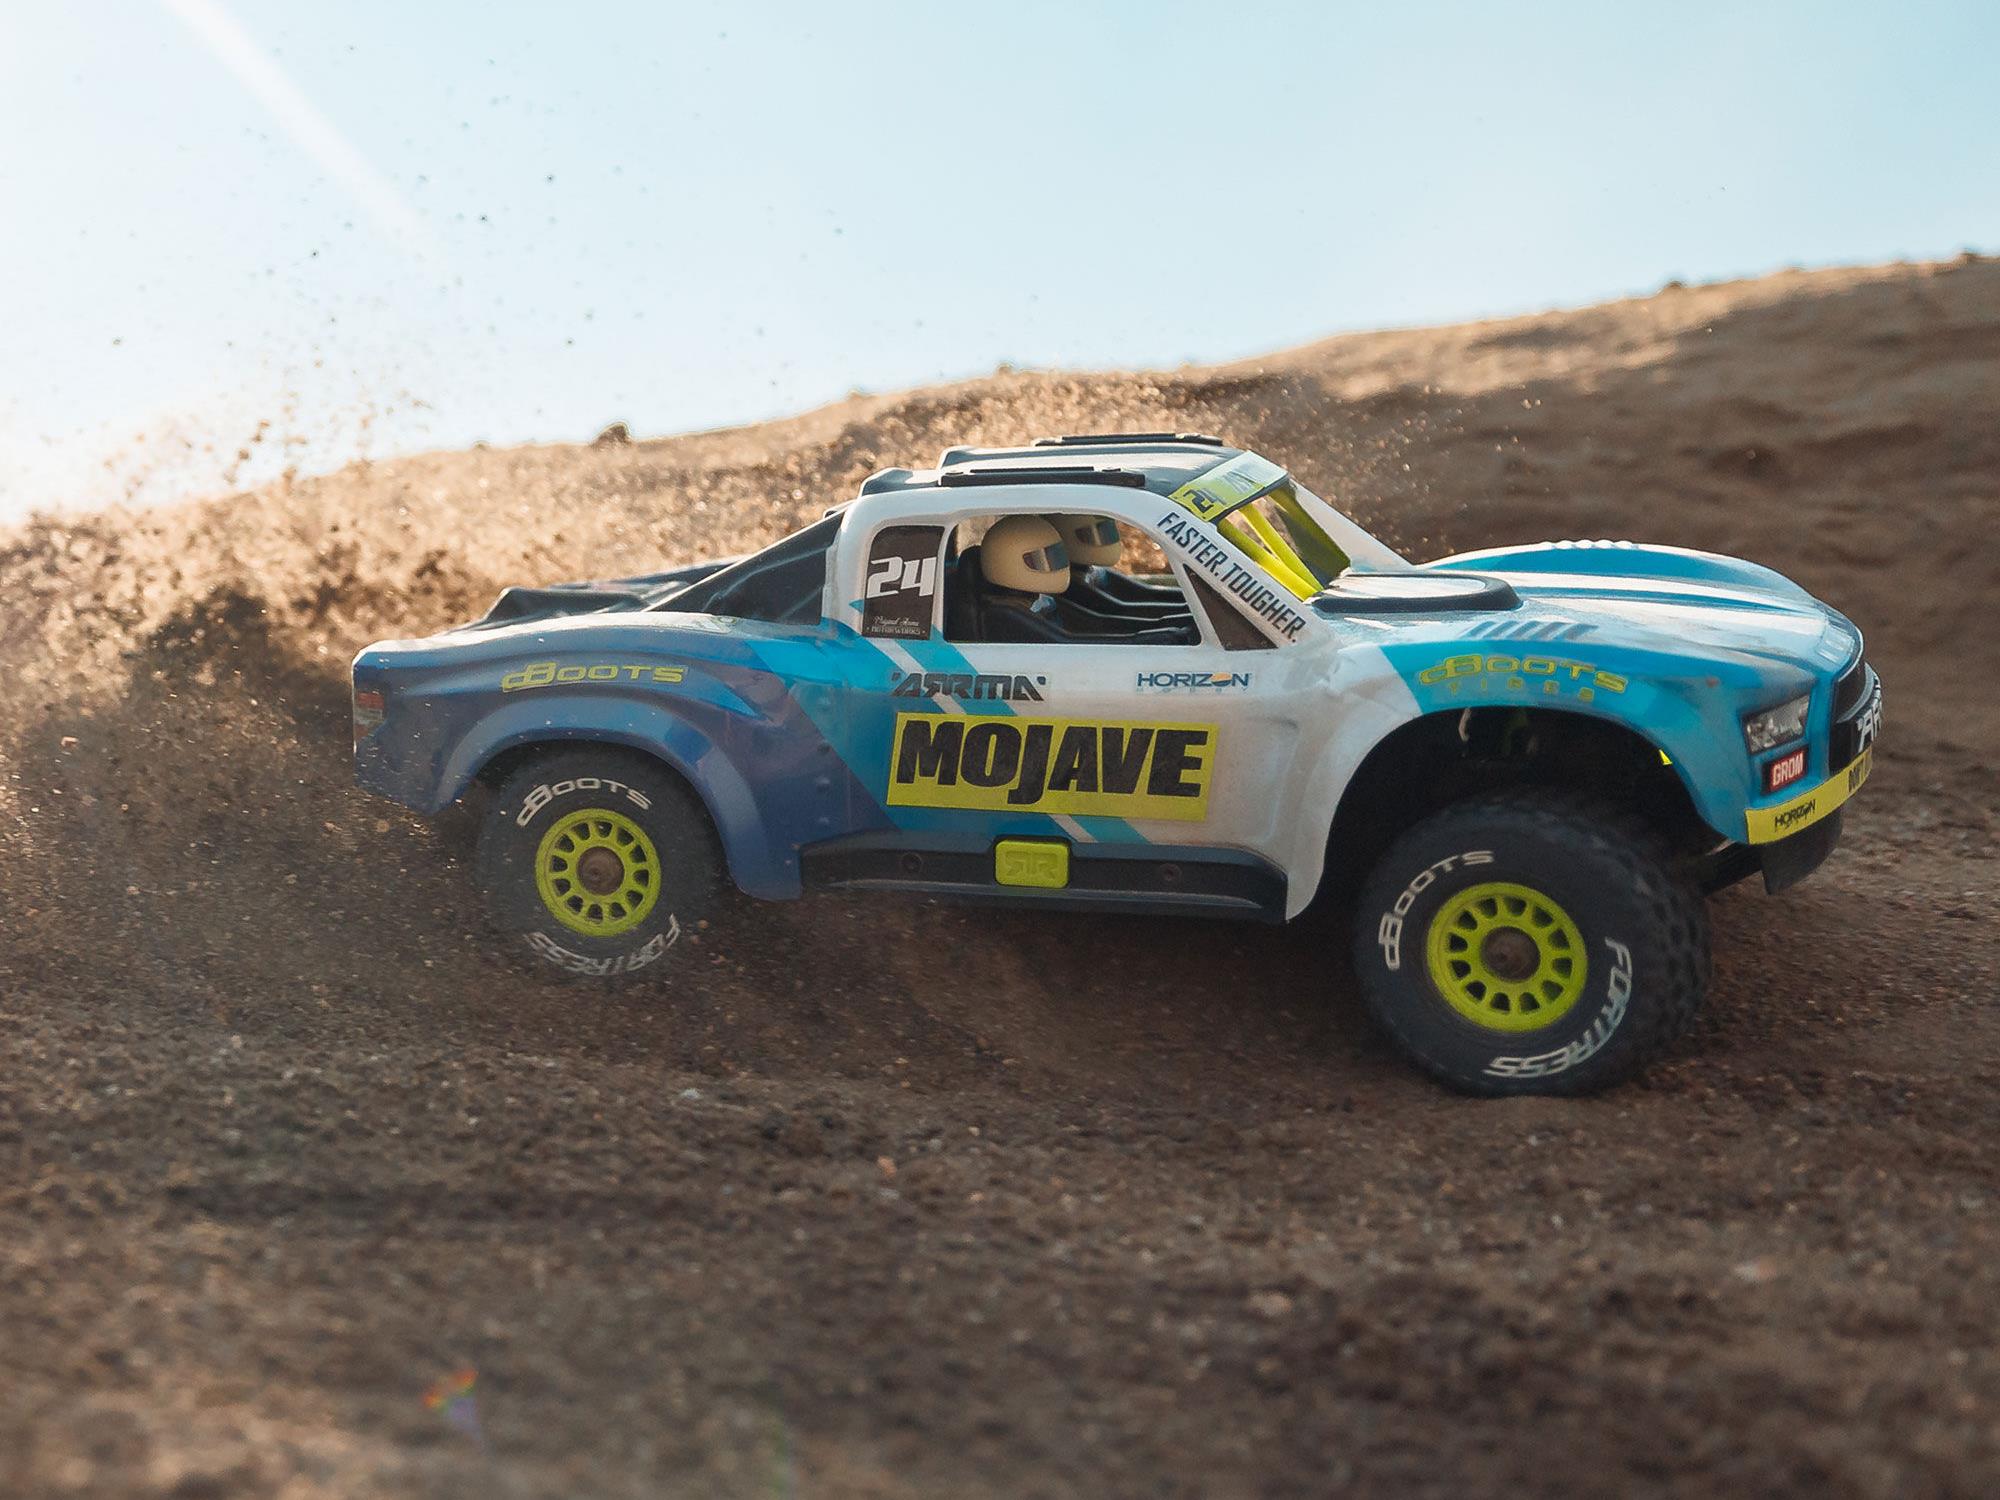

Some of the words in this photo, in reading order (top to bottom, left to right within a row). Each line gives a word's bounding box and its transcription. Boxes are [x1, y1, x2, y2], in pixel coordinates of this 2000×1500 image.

[866, 556, 937, 599] 24
[1137, 672, 1250, 687] HORIZON
[896, 720, 1209, 805] MOJAVE
[1772, 751, 1804, 786] GROM
[1482, 936, 1632, 1078] FORTRESS
